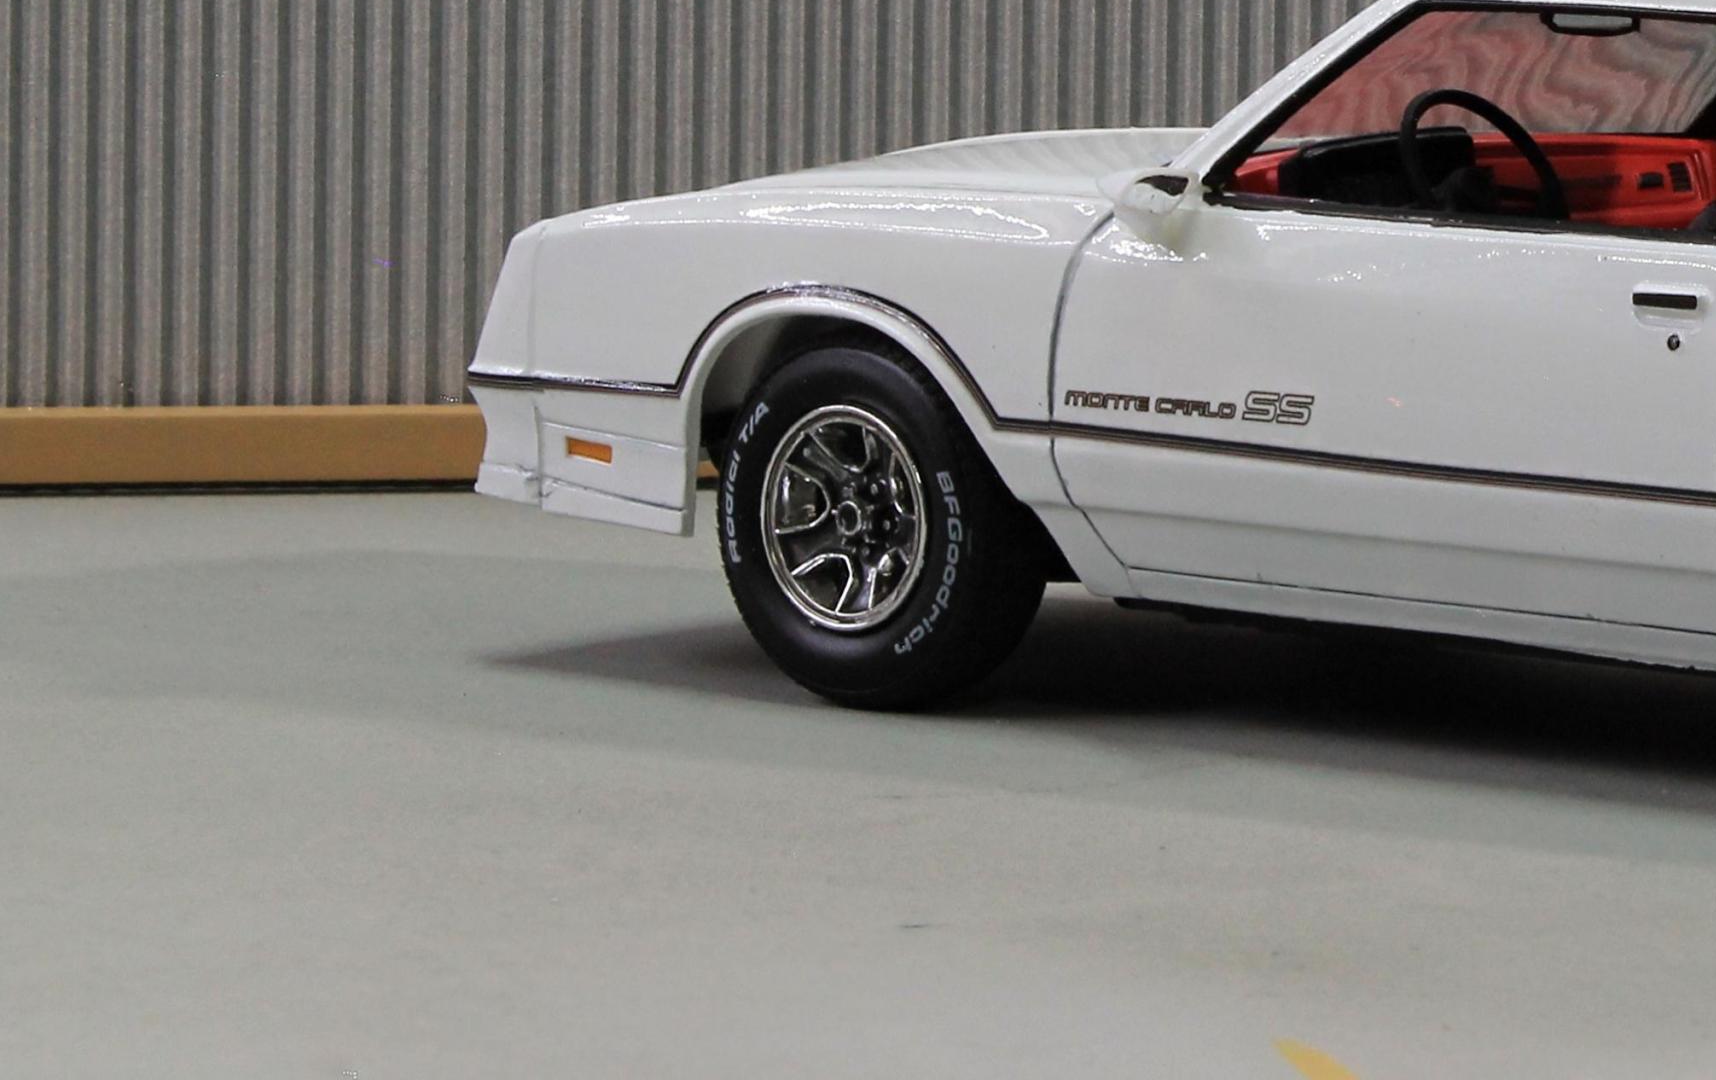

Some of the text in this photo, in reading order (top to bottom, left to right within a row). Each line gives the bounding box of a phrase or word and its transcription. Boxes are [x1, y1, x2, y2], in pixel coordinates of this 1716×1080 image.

[1064, 390, 1314, 426] MONTE CARLO SS
